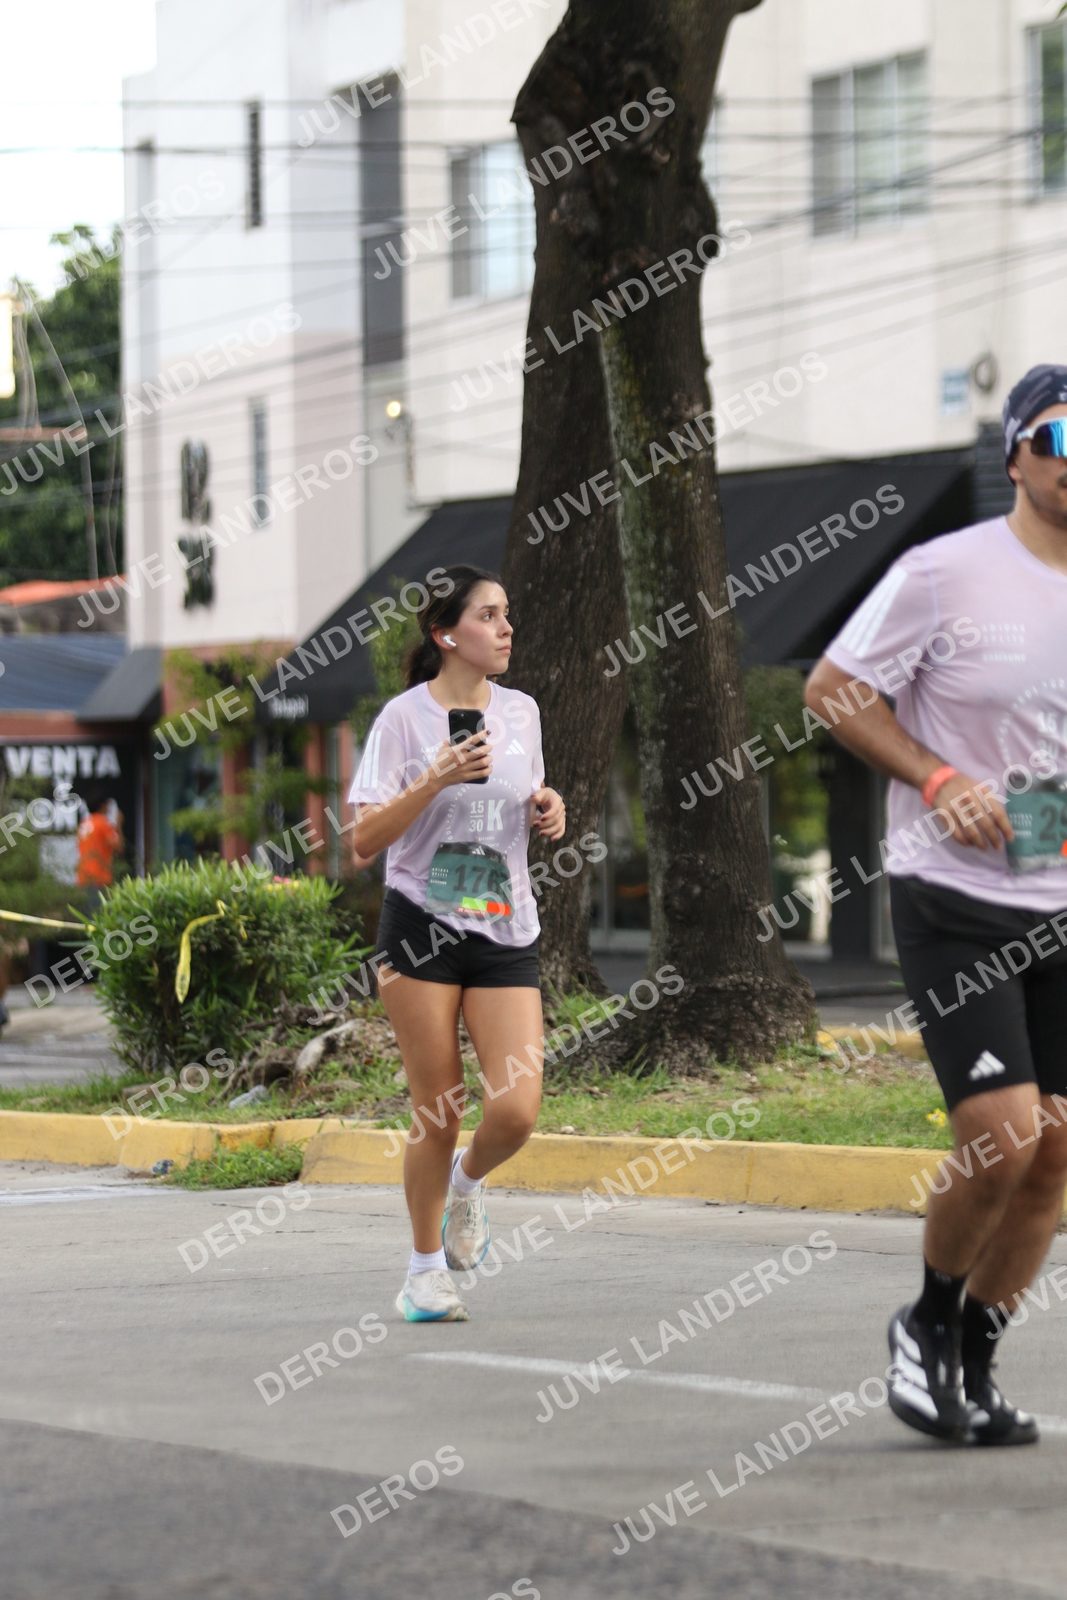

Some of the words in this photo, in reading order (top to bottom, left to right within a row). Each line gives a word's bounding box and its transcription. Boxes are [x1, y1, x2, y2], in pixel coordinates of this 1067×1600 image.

[4, 745, 121, 779] VENTA
[470, 800, 484, 815] 15
[487, 799, 507, 832] K
[468, 819, 484, 833] 30
